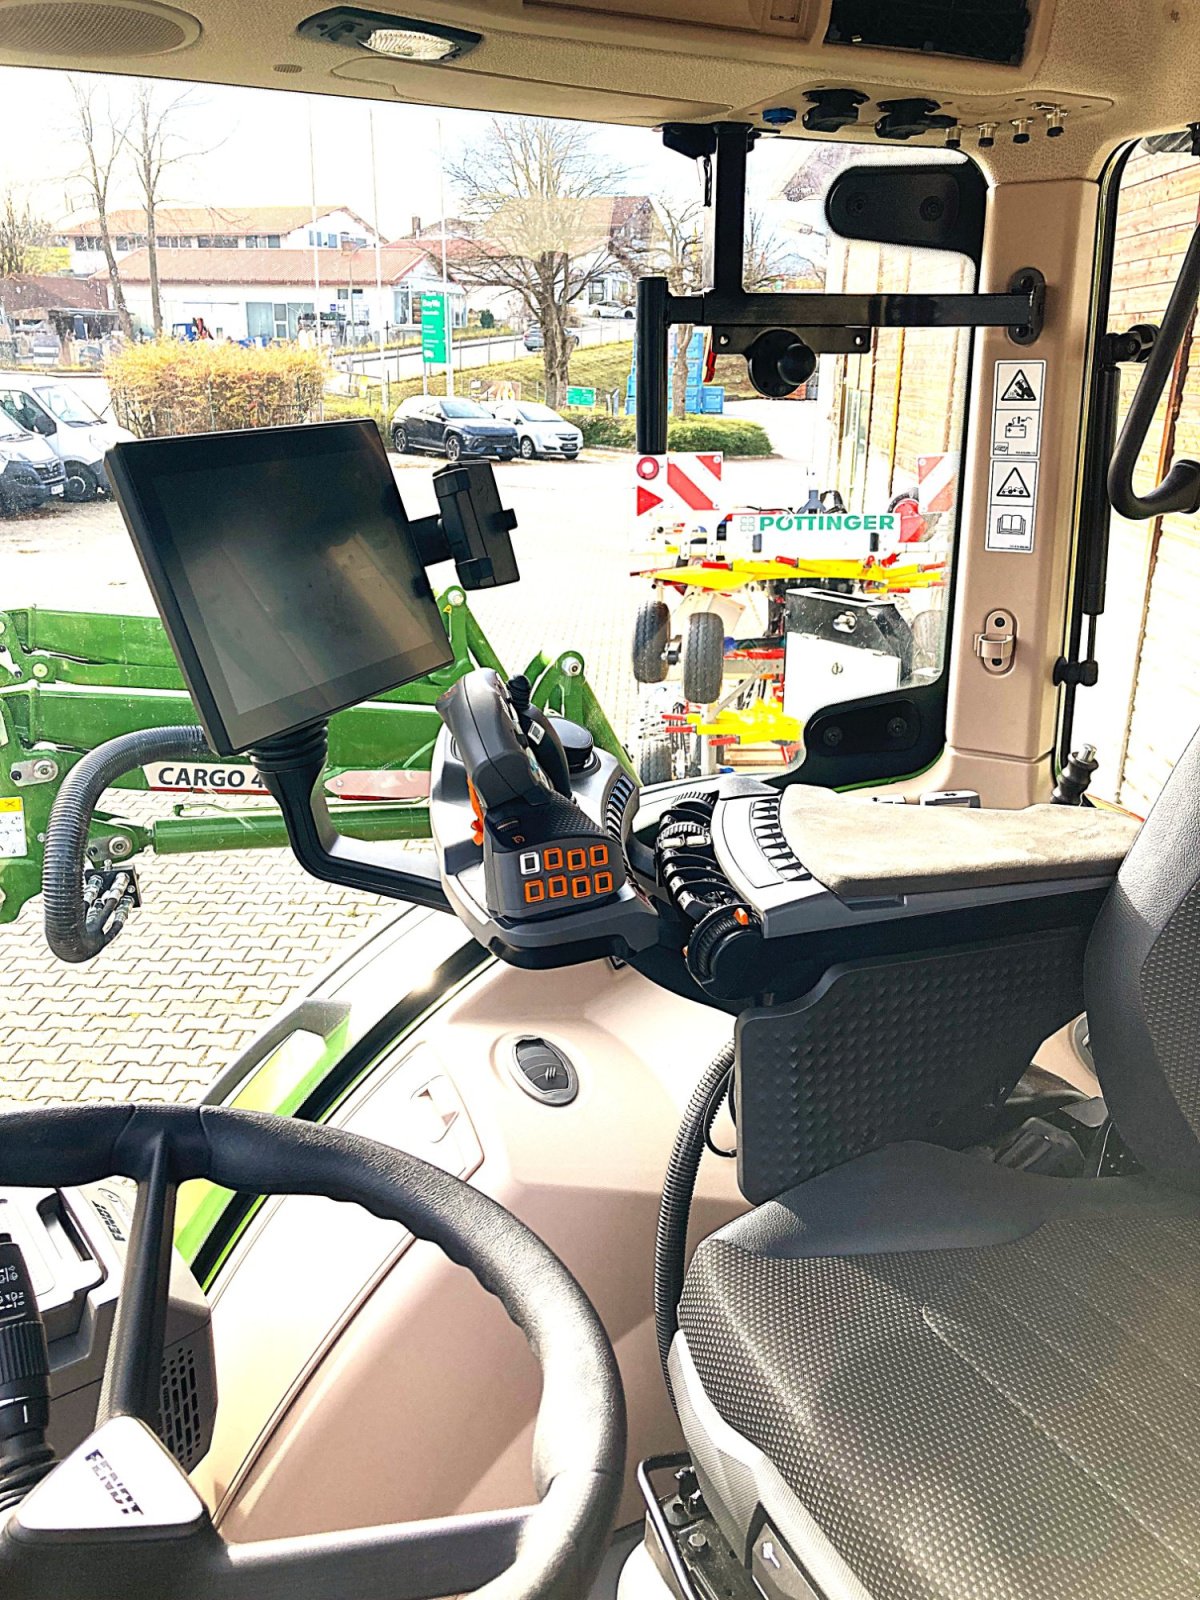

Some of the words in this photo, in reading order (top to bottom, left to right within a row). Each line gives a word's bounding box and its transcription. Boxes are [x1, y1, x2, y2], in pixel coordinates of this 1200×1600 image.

[158, 767, 245, 787] CARGO
[91, 1200, 126, 1242] FENDT
[85, 1449, 144, 1515] FENDT
